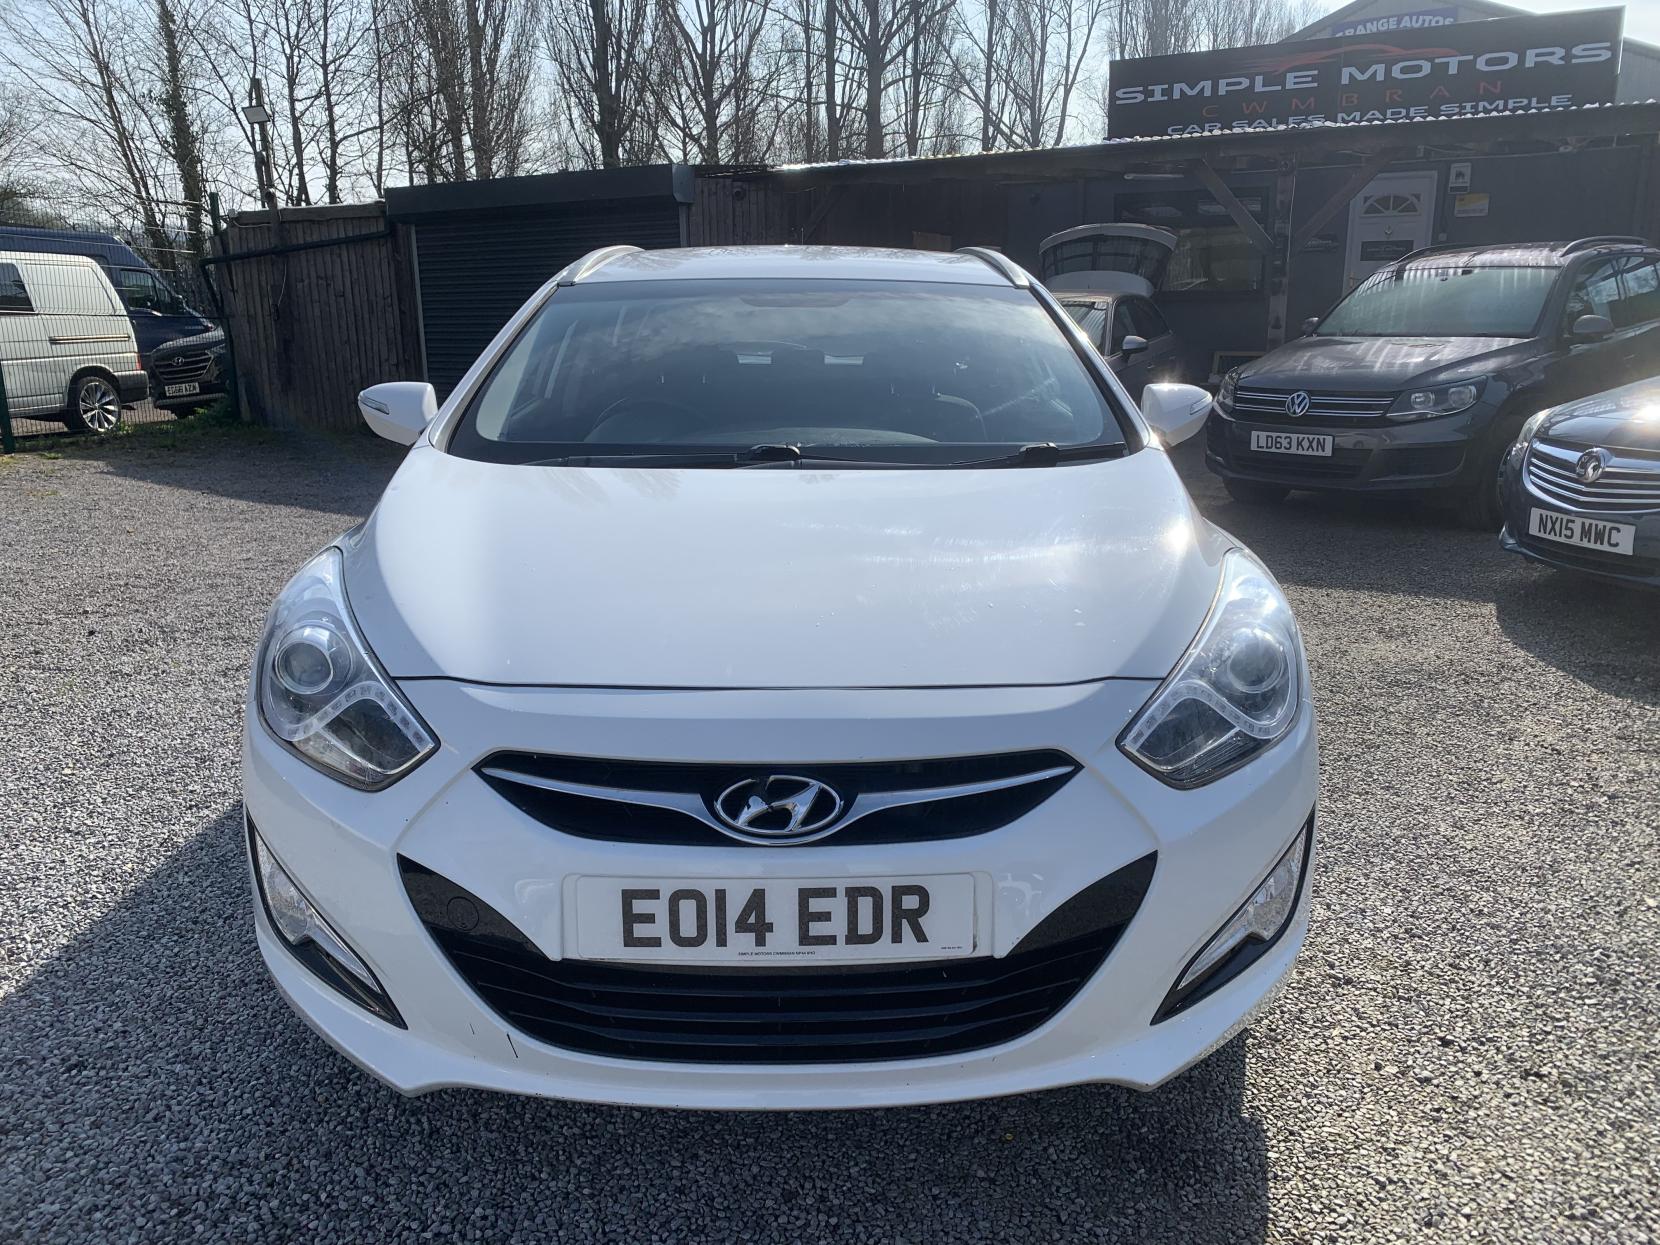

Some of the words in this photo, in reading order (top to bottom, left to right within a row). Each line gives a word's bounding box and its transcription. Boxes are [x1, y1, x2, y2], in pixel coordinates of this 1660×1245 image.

[1335, 17, 1398, 37] RANGE
[1115, 70, 1319, 104] SIMPLE
[1341, 42, 1612, 84] MOTORS
[1167, 122, 1222, 135] CAR
[1232, 114, 1325, 131] SALES
[1337, 106, 1428, 124] MADE
[1440, 94, 1573, 114] SIMPLE
[1256, 434, 1292, 450] LD63
[1296, 436, 1326, 453] KXN
[1538, 513, 1576, 540] NX15
[1580, 520, 1621, 548] MWC
[621, 888, 774, 948] EO14
[798, 884, 930, 945] EDR
